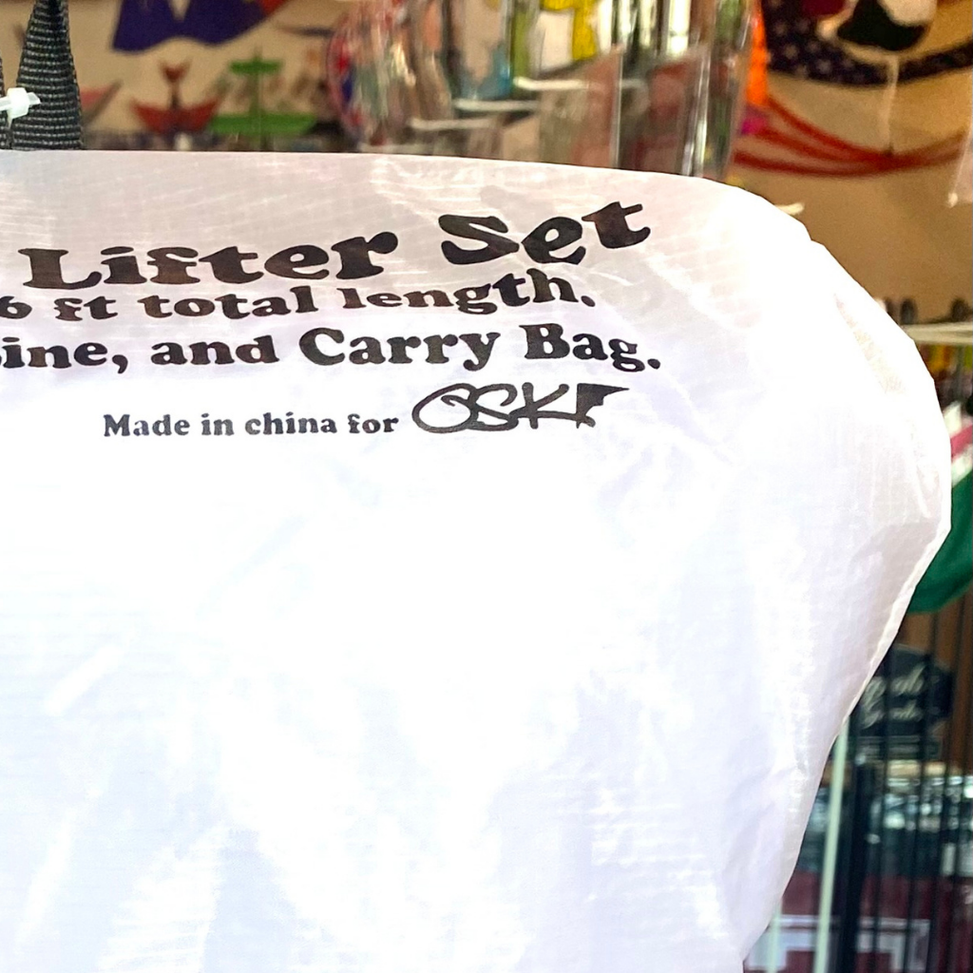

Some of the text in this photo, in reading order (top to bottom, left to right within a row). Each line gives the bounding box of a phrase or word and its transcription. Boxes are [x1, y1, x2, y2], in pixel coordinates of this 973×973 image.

[18, 231, 398, 290] Lifter
[438, 201, 650, 265] Set
[54, 296, 118, 321] ft
[138, 286, 318, 320] total
[337, 268, 596, 316] length.
[151, 335, 279, 366] and
[299, 328, 500, 372] Carry
[519, 323, 661, 373] Bag.
[103, 414, 190, 437] Made
[201, 413, 234, 436] in
[245, 412, 337, 435] china
[347, 413, 399, 435] for
